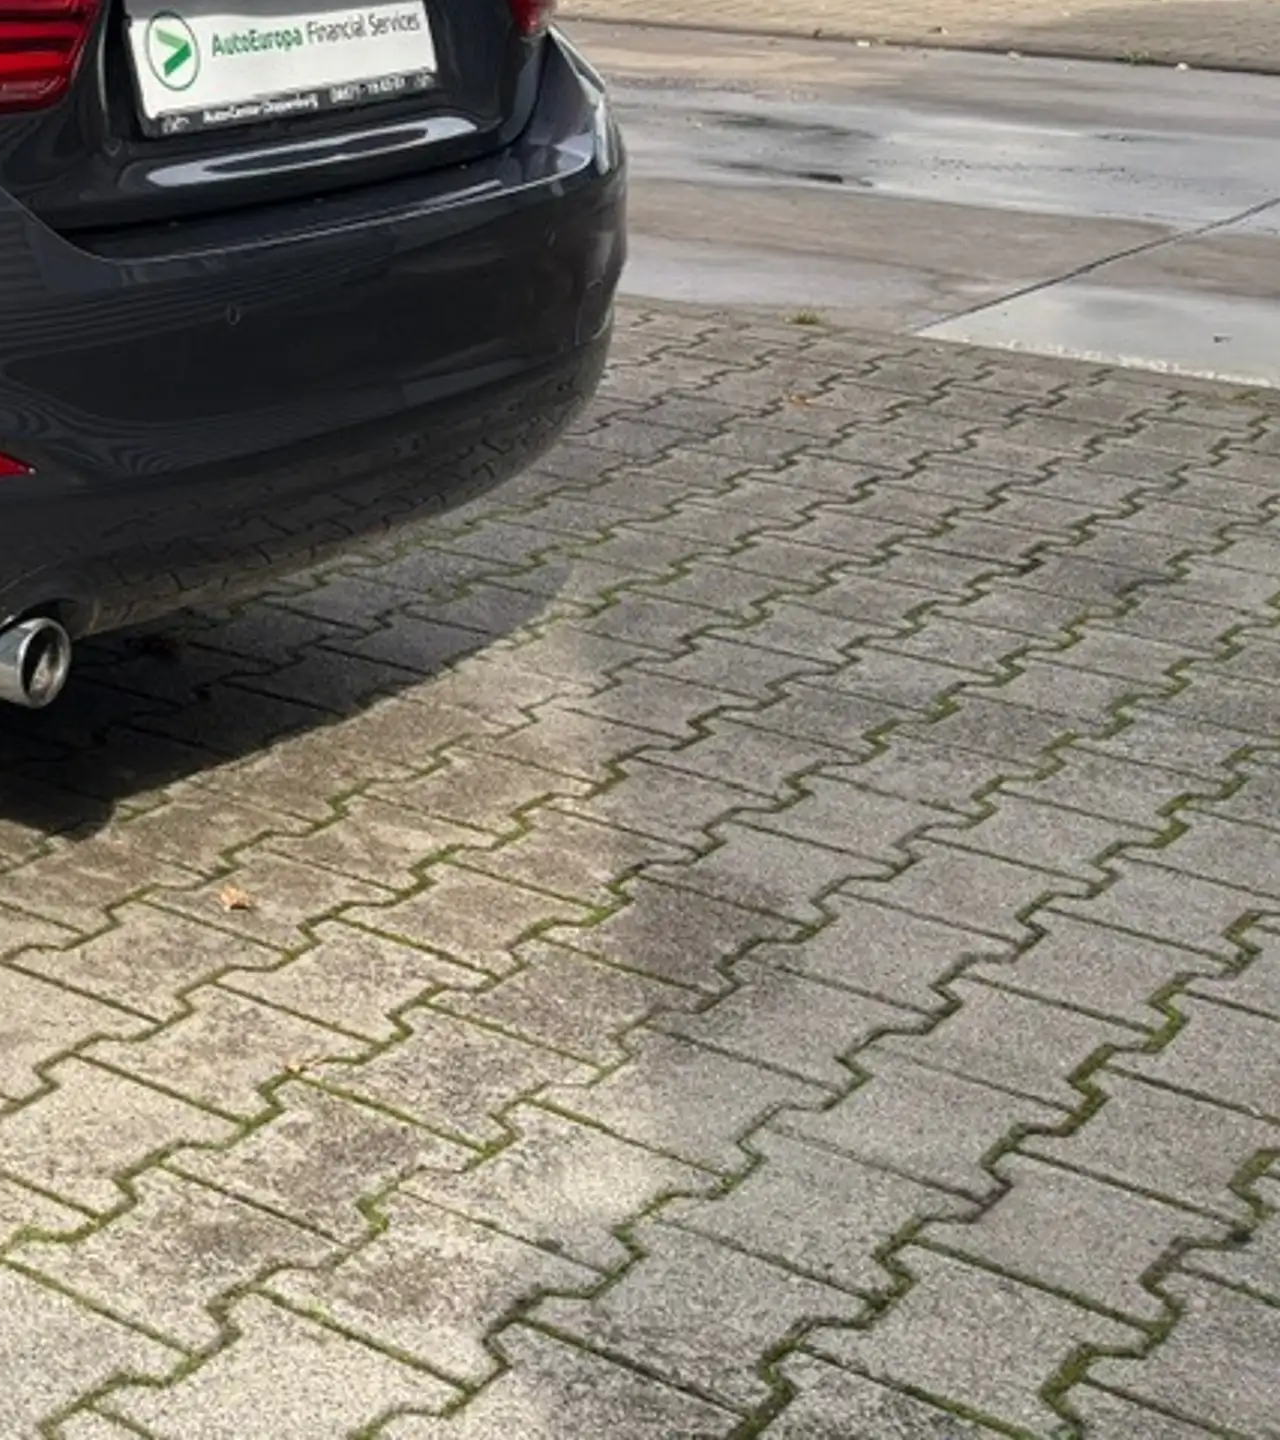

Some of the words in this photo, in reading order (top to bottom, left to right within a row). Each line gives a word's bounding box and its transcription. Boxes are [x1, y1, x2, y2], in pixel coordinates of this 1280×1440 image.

[211, 27, 303, 57] AutoEuropa
[305, 13, 366, 44] Financial
[367, 10, 421, 36] Services
